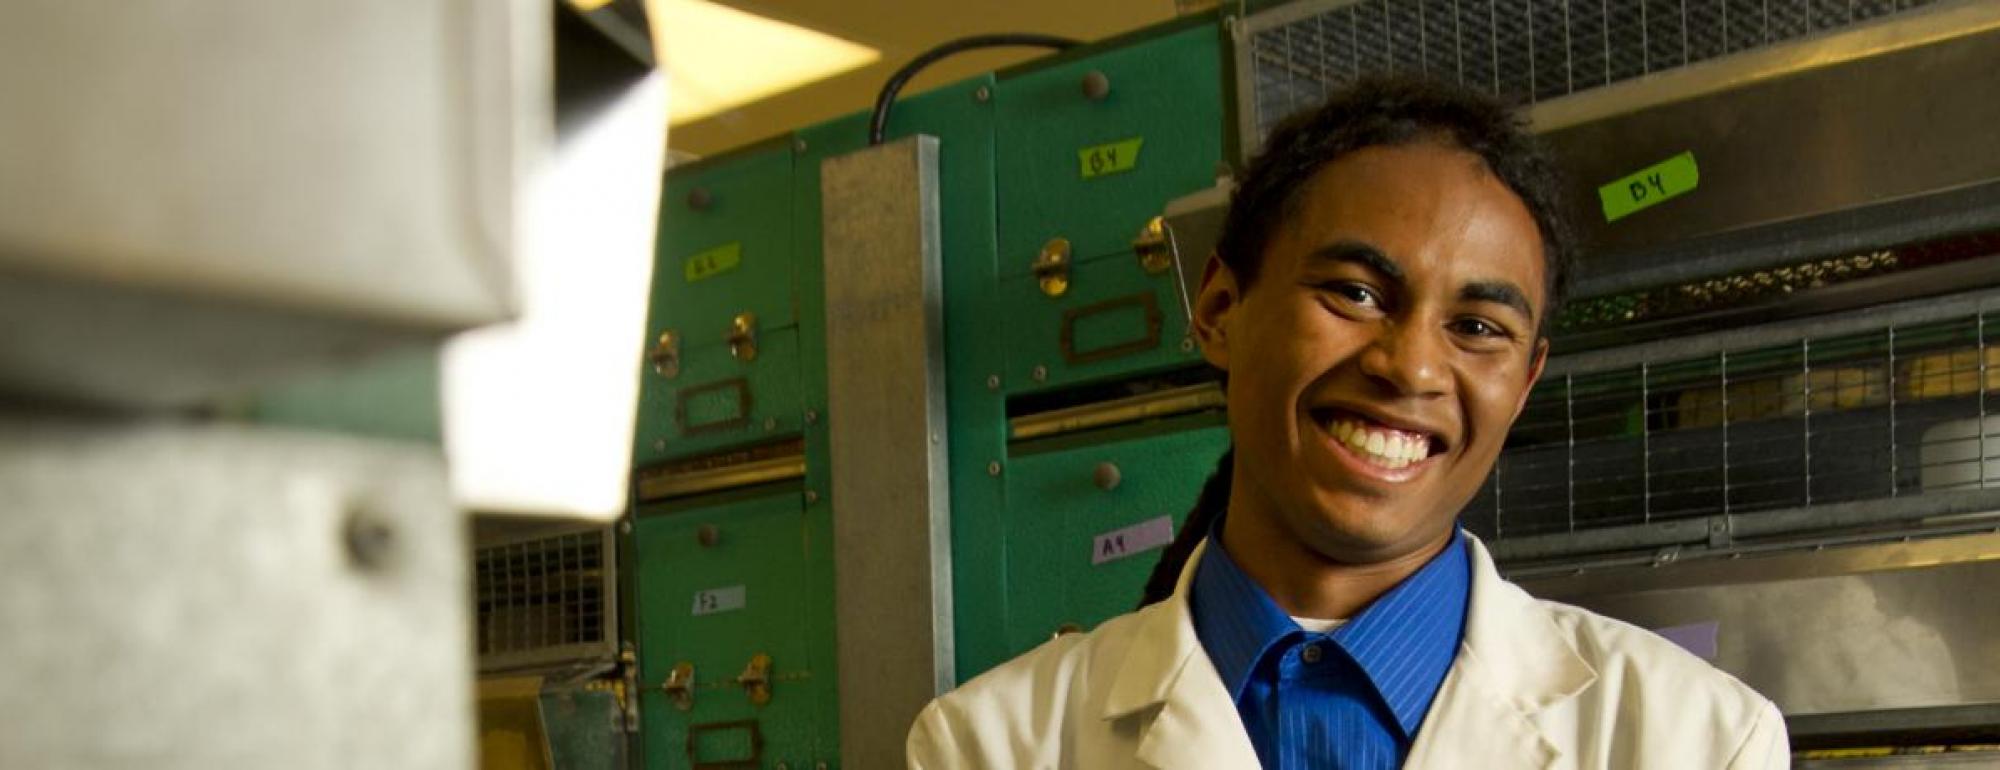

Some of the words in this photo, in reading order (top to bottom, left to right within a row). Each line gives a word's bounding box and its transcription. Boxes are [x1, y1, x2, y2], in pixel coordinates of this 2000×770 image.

[1090, 148, 1117, 174] B4
[1629, 172, 1666, 202] B4
[1103, 534, 1126, 557] A4
[700, 591, 718, 611] F2
